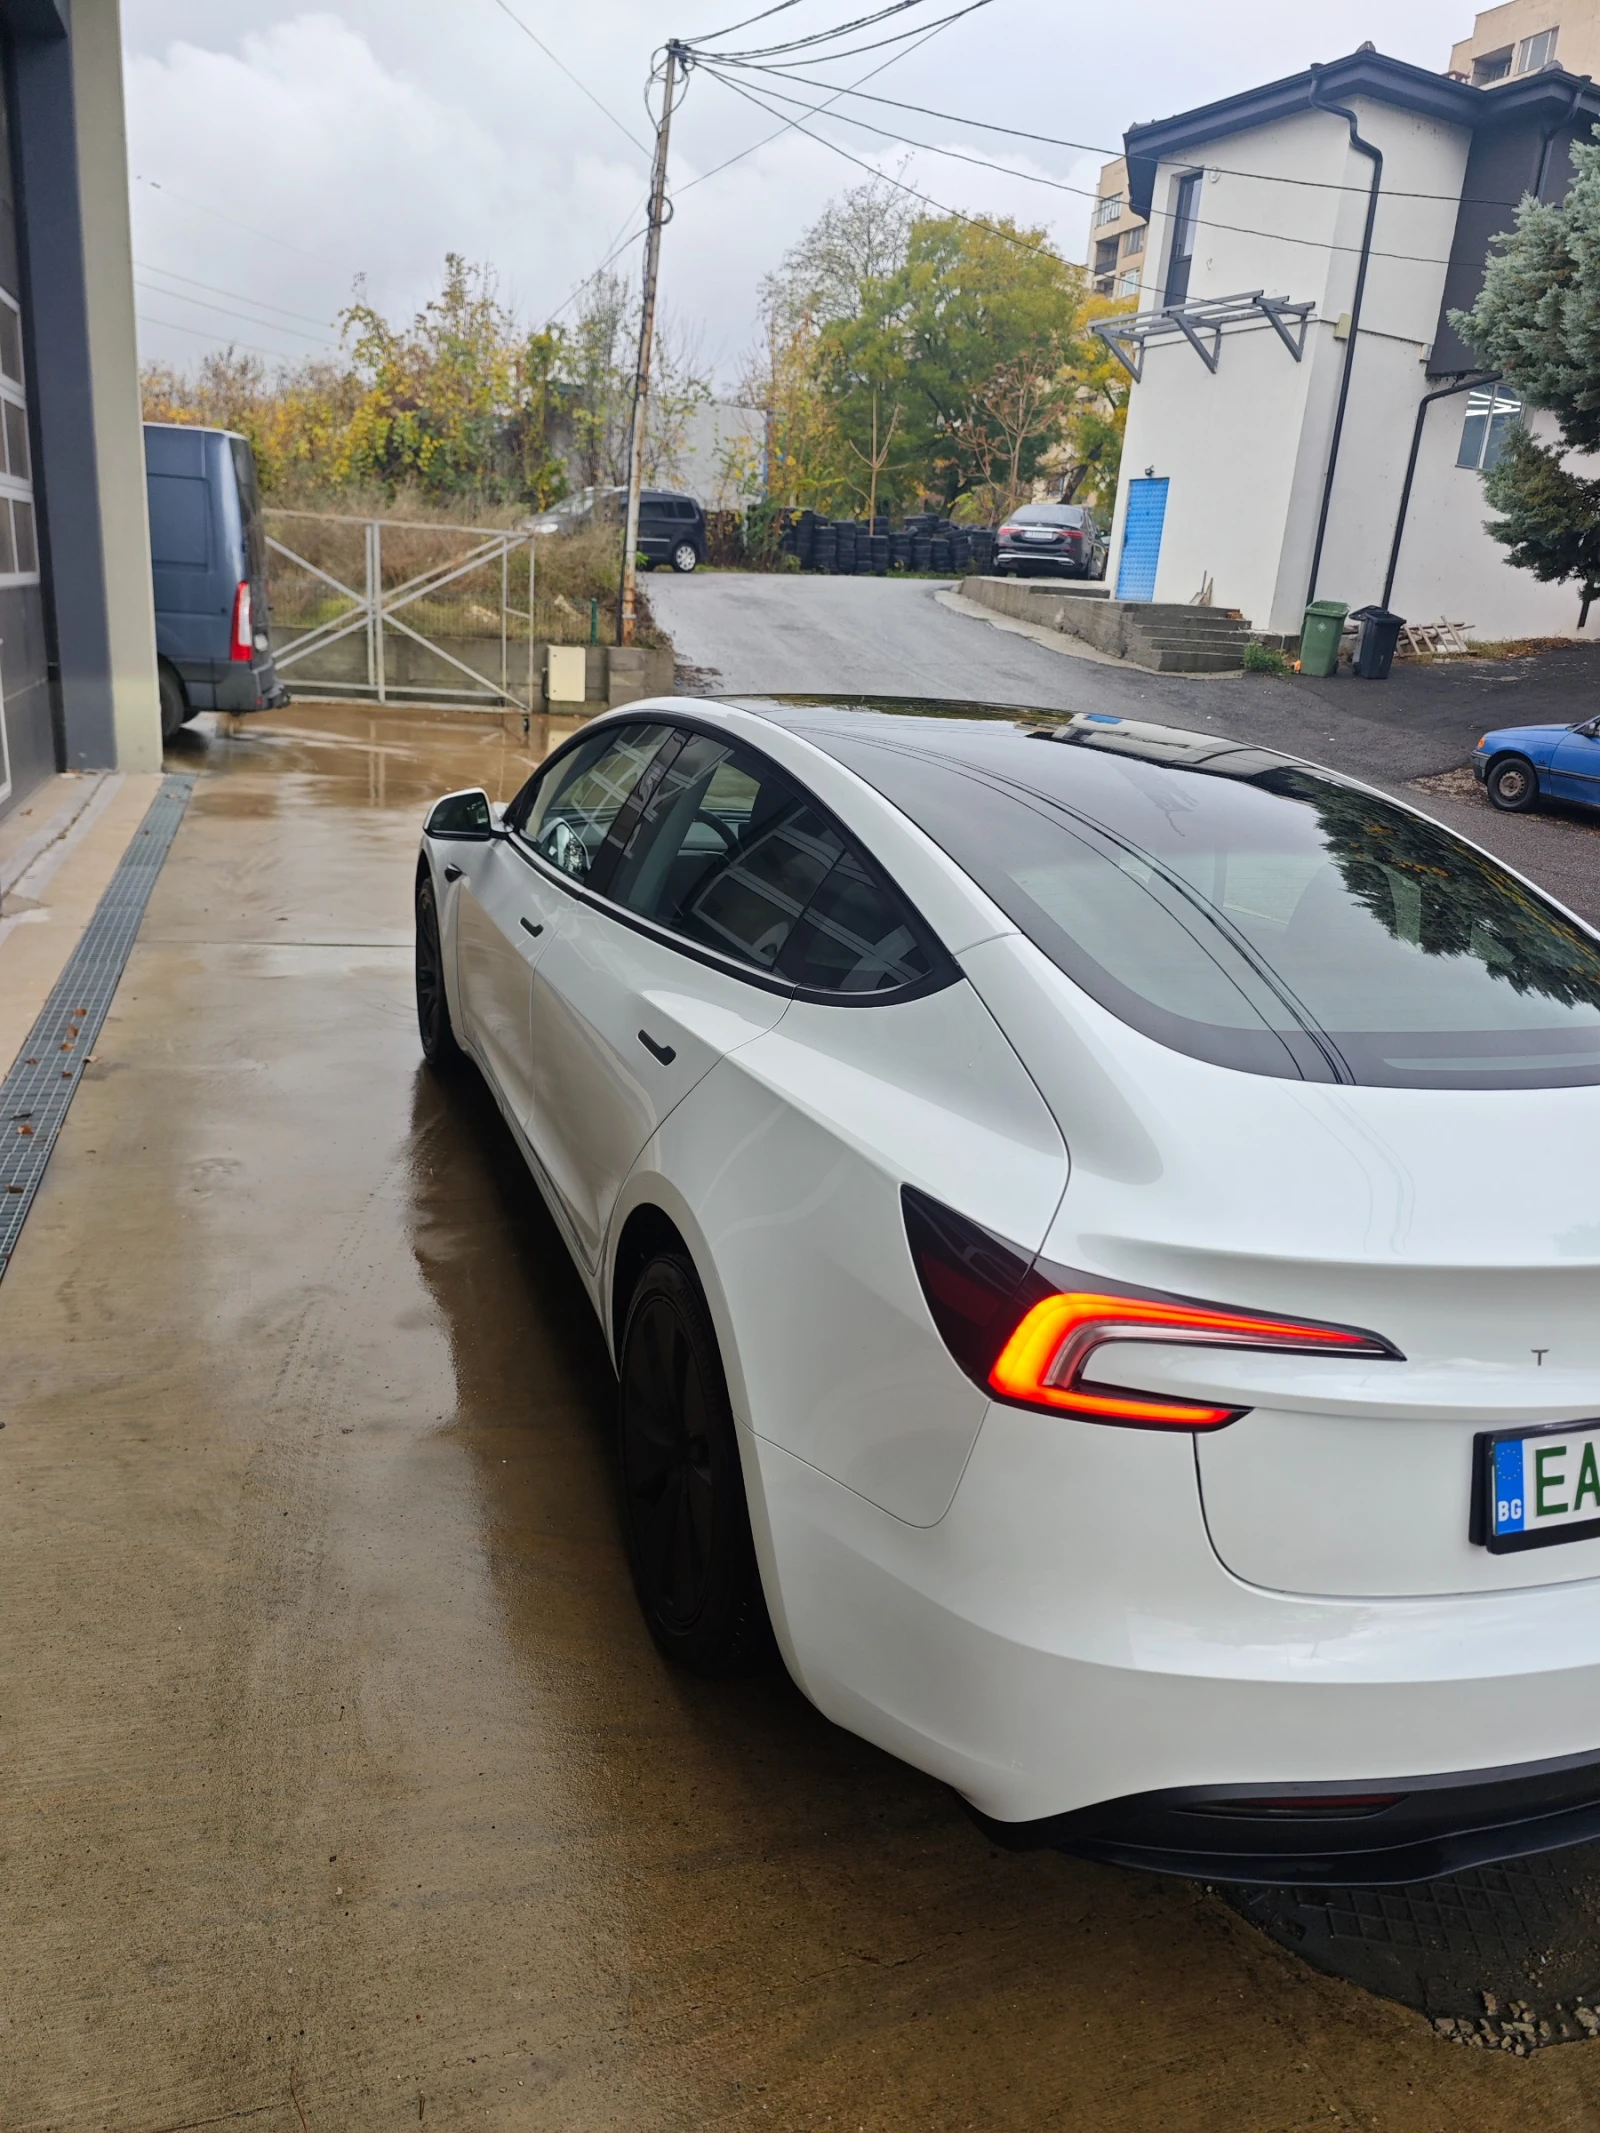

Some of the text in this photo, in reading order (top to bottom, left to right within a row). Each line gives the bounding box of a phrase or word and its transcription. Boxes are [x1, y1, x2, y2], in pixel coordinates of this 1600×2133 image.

[1530, 1348, 1550, 1366] T
[1535, 1442, 1600, 1517] EA
[1497, 1498, 1522, 1522] BG
